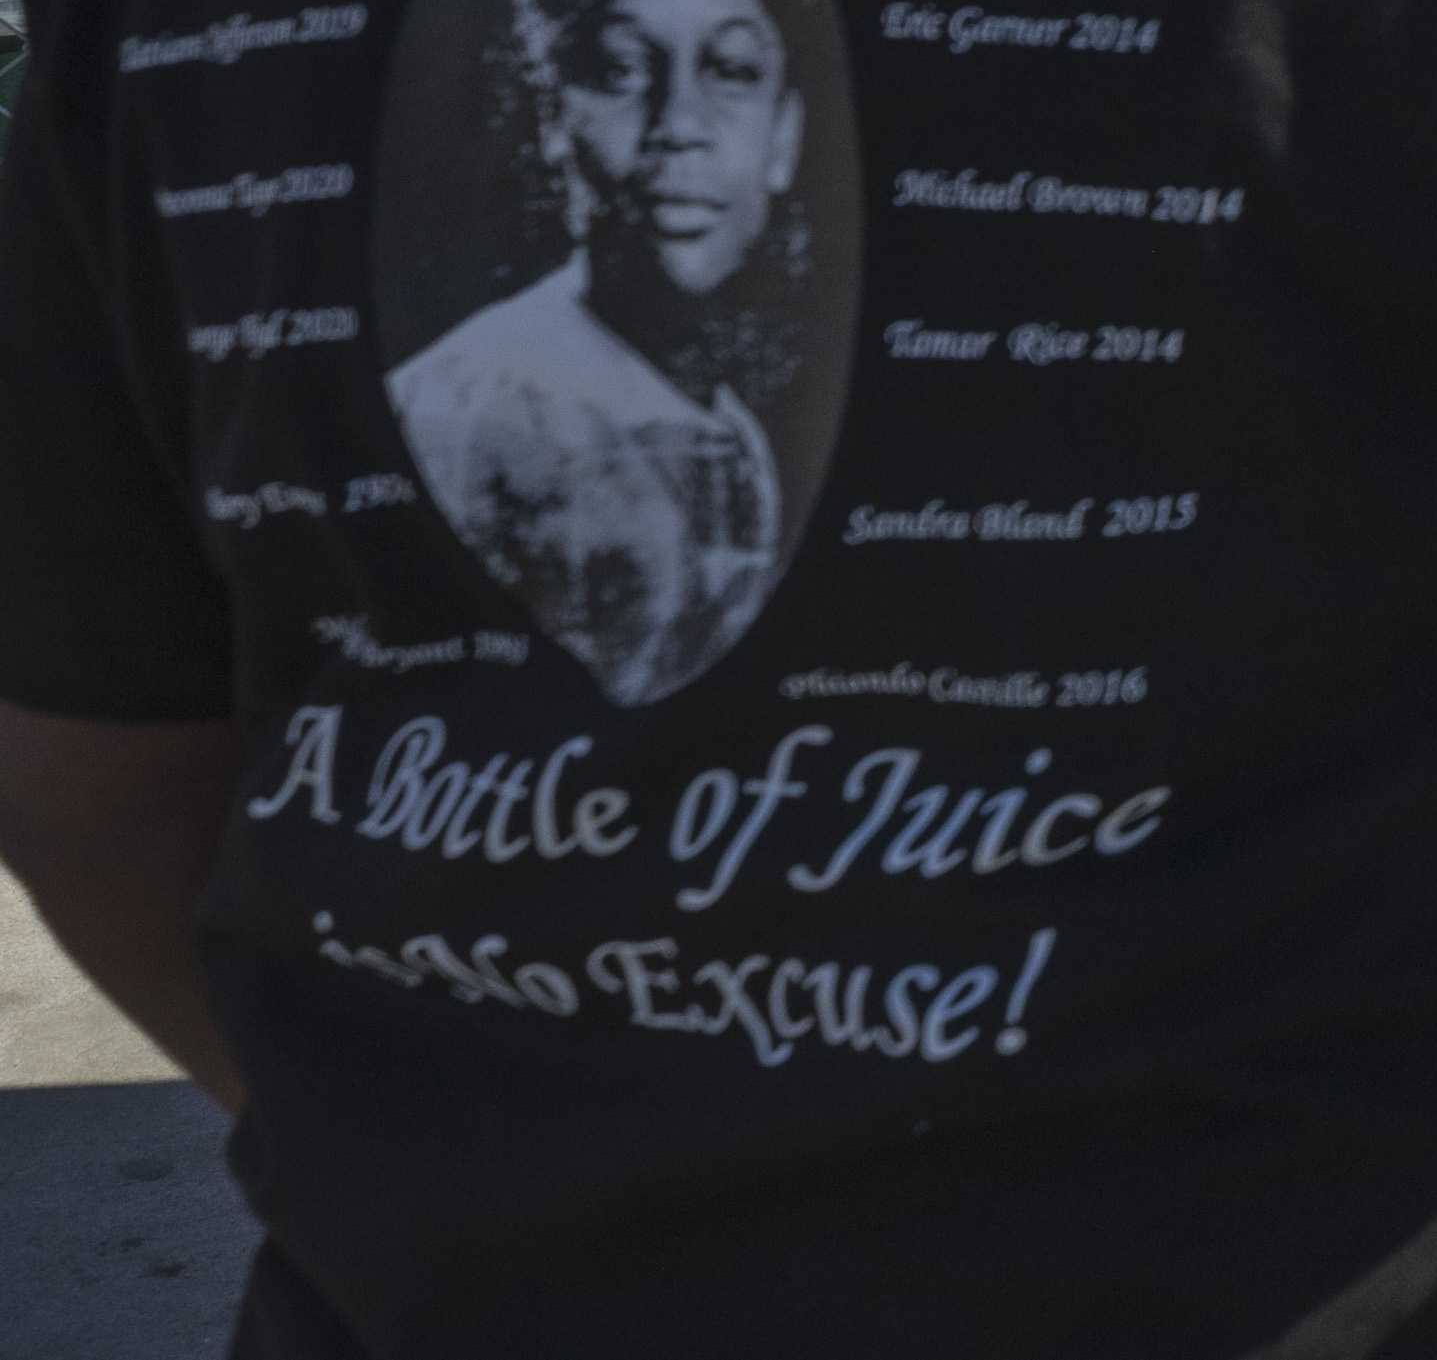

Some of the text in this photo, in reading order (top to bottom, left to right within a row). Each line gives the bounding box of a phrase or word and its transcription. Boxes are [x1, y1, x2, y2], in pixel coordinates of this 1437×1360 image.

[1067, 12, 1162, 54] 2014
[1149, 186, 1246, 224] 2014
[1091, 324, 1186, 363] 2014
[1101, 490, 1200, 538] 2015
[1053, 664, 1150, 707] 2016
[247, 705, 1172, 912] A Bottle of Juice
[586, 927, 1058, 1069] Excuse!
